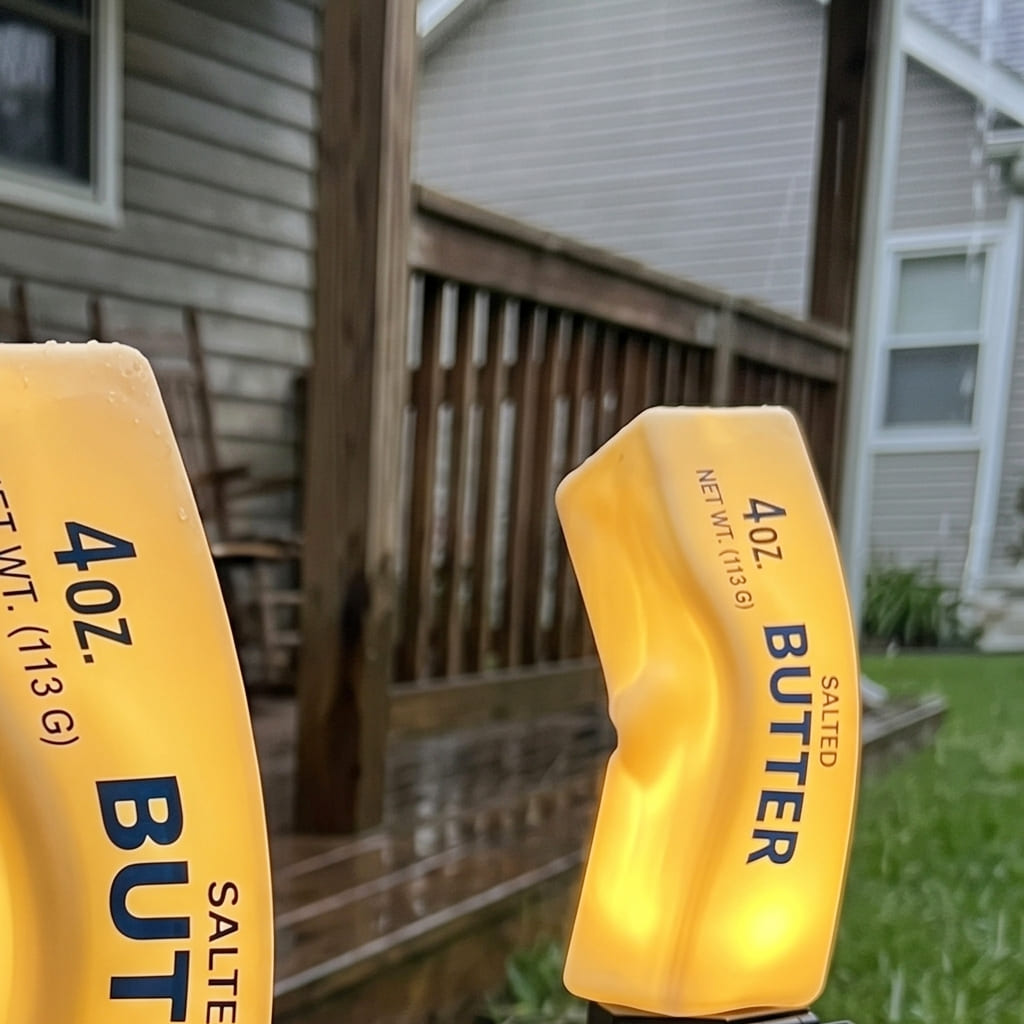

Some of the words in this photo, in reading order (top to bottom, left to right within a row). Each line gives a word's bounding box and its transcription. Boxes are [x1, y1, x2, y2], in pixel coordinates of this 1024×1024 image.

[695, 468, 724, 505] NET
[710, 509, 735, 545] WT.
[718, 548, 747, 586] (113
[734, 589, 755, 610] G)
[7, 625, 65, 698] (113
[39, 708, 80, 746] G)
[820, 675, 840, 768] SALTED
[746, 623, 813, 865] BUTTER
